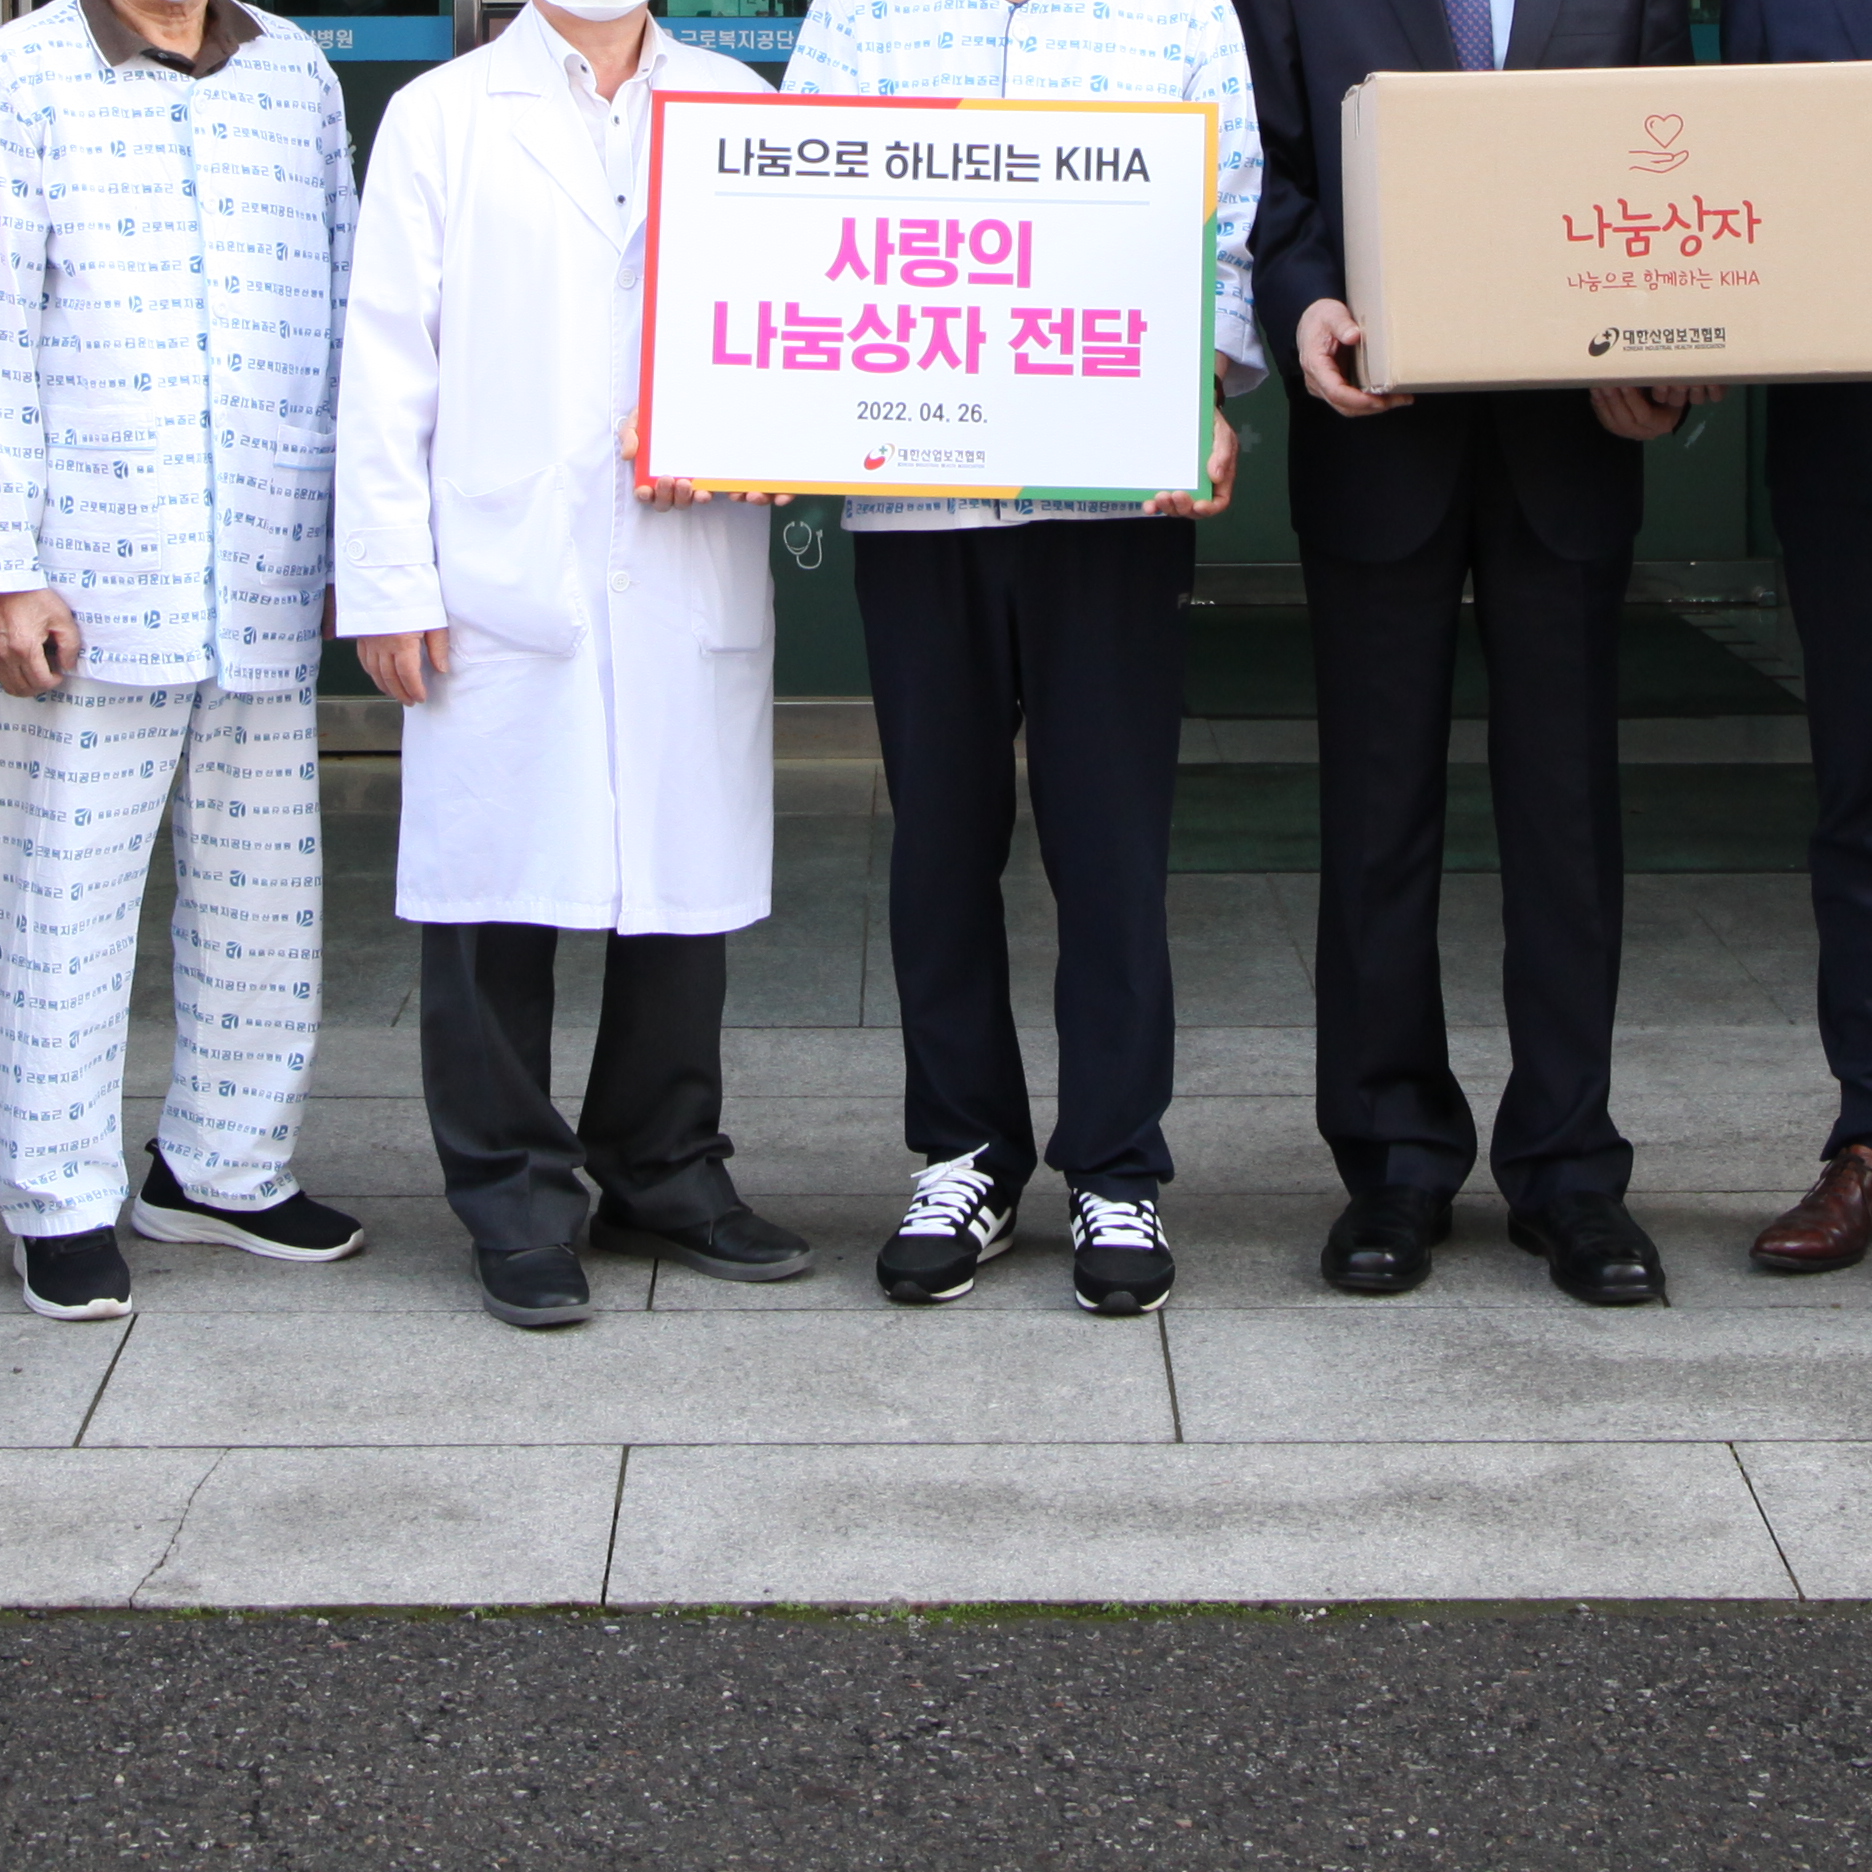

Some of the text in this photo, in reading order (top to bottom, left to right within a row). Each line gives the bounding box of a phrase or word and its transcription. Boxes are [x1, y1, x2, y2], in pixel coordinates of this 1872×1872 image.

[679, 29, 795, 50] 근로복지공단
[718, 137, 1151, 184] 나눔으로 하나되는 KIHA
[1562, 194, 1762, 258] 나눔상자
[825, 216, 1033, 289] 사랑의
[1567, 268, 1760, 293] 나눔으로 함께하는 KIHA
[711, 299, 1149, 378] 나눔상자 전달
[1622, 327, 1726, 345] 대한산업보건협회
[856, 400, 988, 424] 2022. 04. 26.
